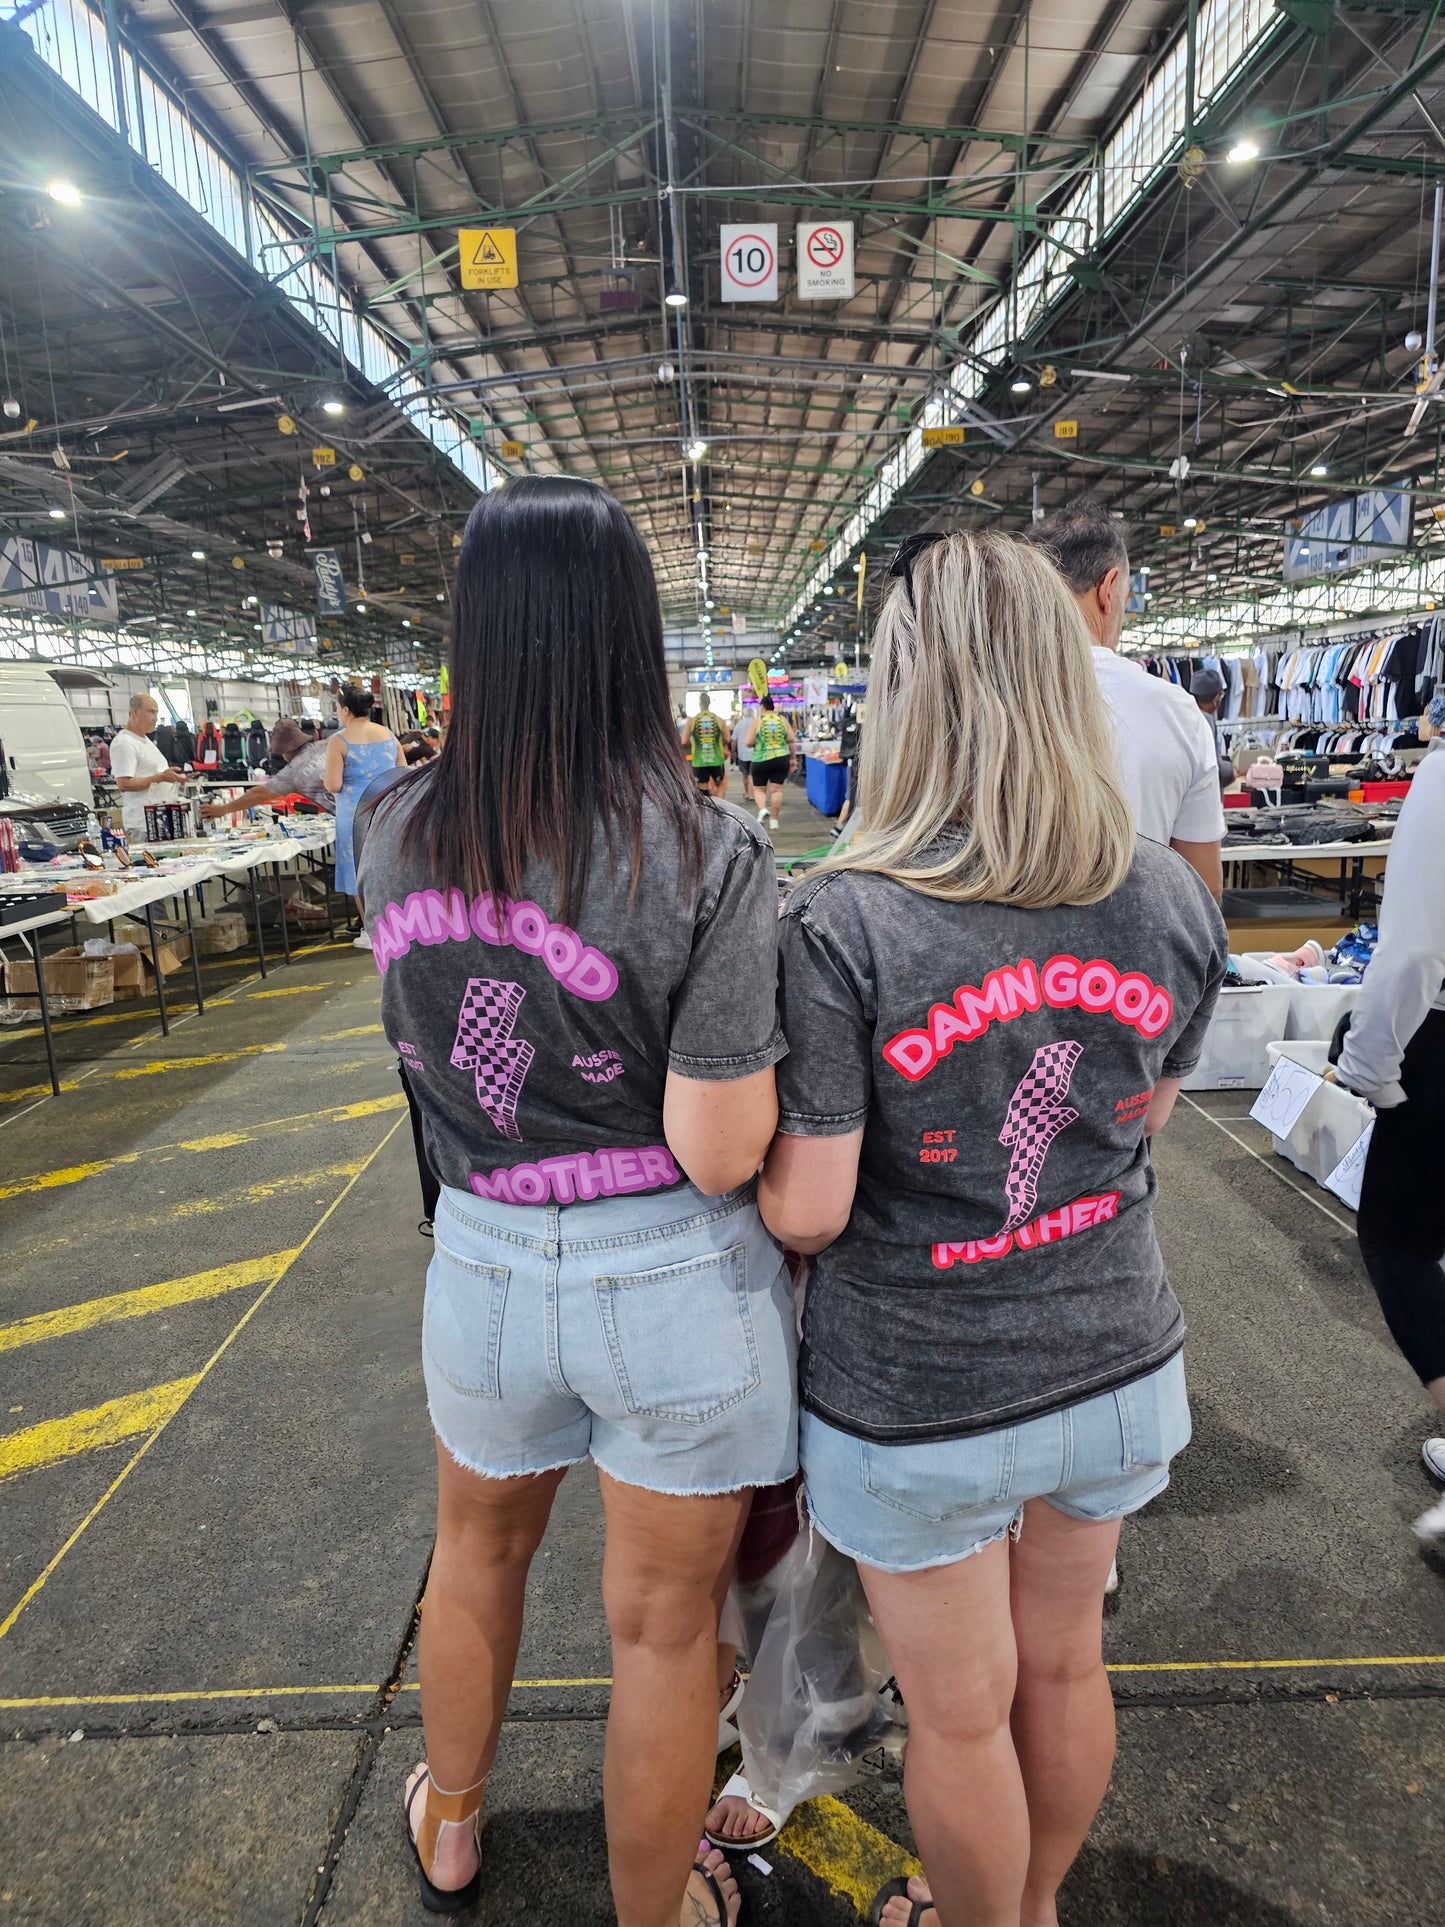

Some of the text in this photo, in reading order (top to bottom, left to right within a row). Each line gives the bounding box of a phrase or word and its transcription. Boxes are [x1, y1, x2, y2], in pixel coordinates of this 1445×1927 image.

[732, 248, 765, 273] 10
[468, 268, 511, 276] FORKLIFTS
[487, 276, 503, 284] USE
[807, 279, 846, 287] SMOKING
[73, 595, 89, 615] 140
[371, 889, 617, 999] DAMN GOOD
[884, 956, 1172, 1079] DAMN GOOD
[397, 1041, 416, 1055] EST
[571, 1049, 623, 1068] AUSSIE
[580, 1062, 625, 1083] MADE
[923, 1129, 957, 1143] EST
[919, 1148, 958, 1163] 2017
[470, 1147, 678, 1205] MOTHER
